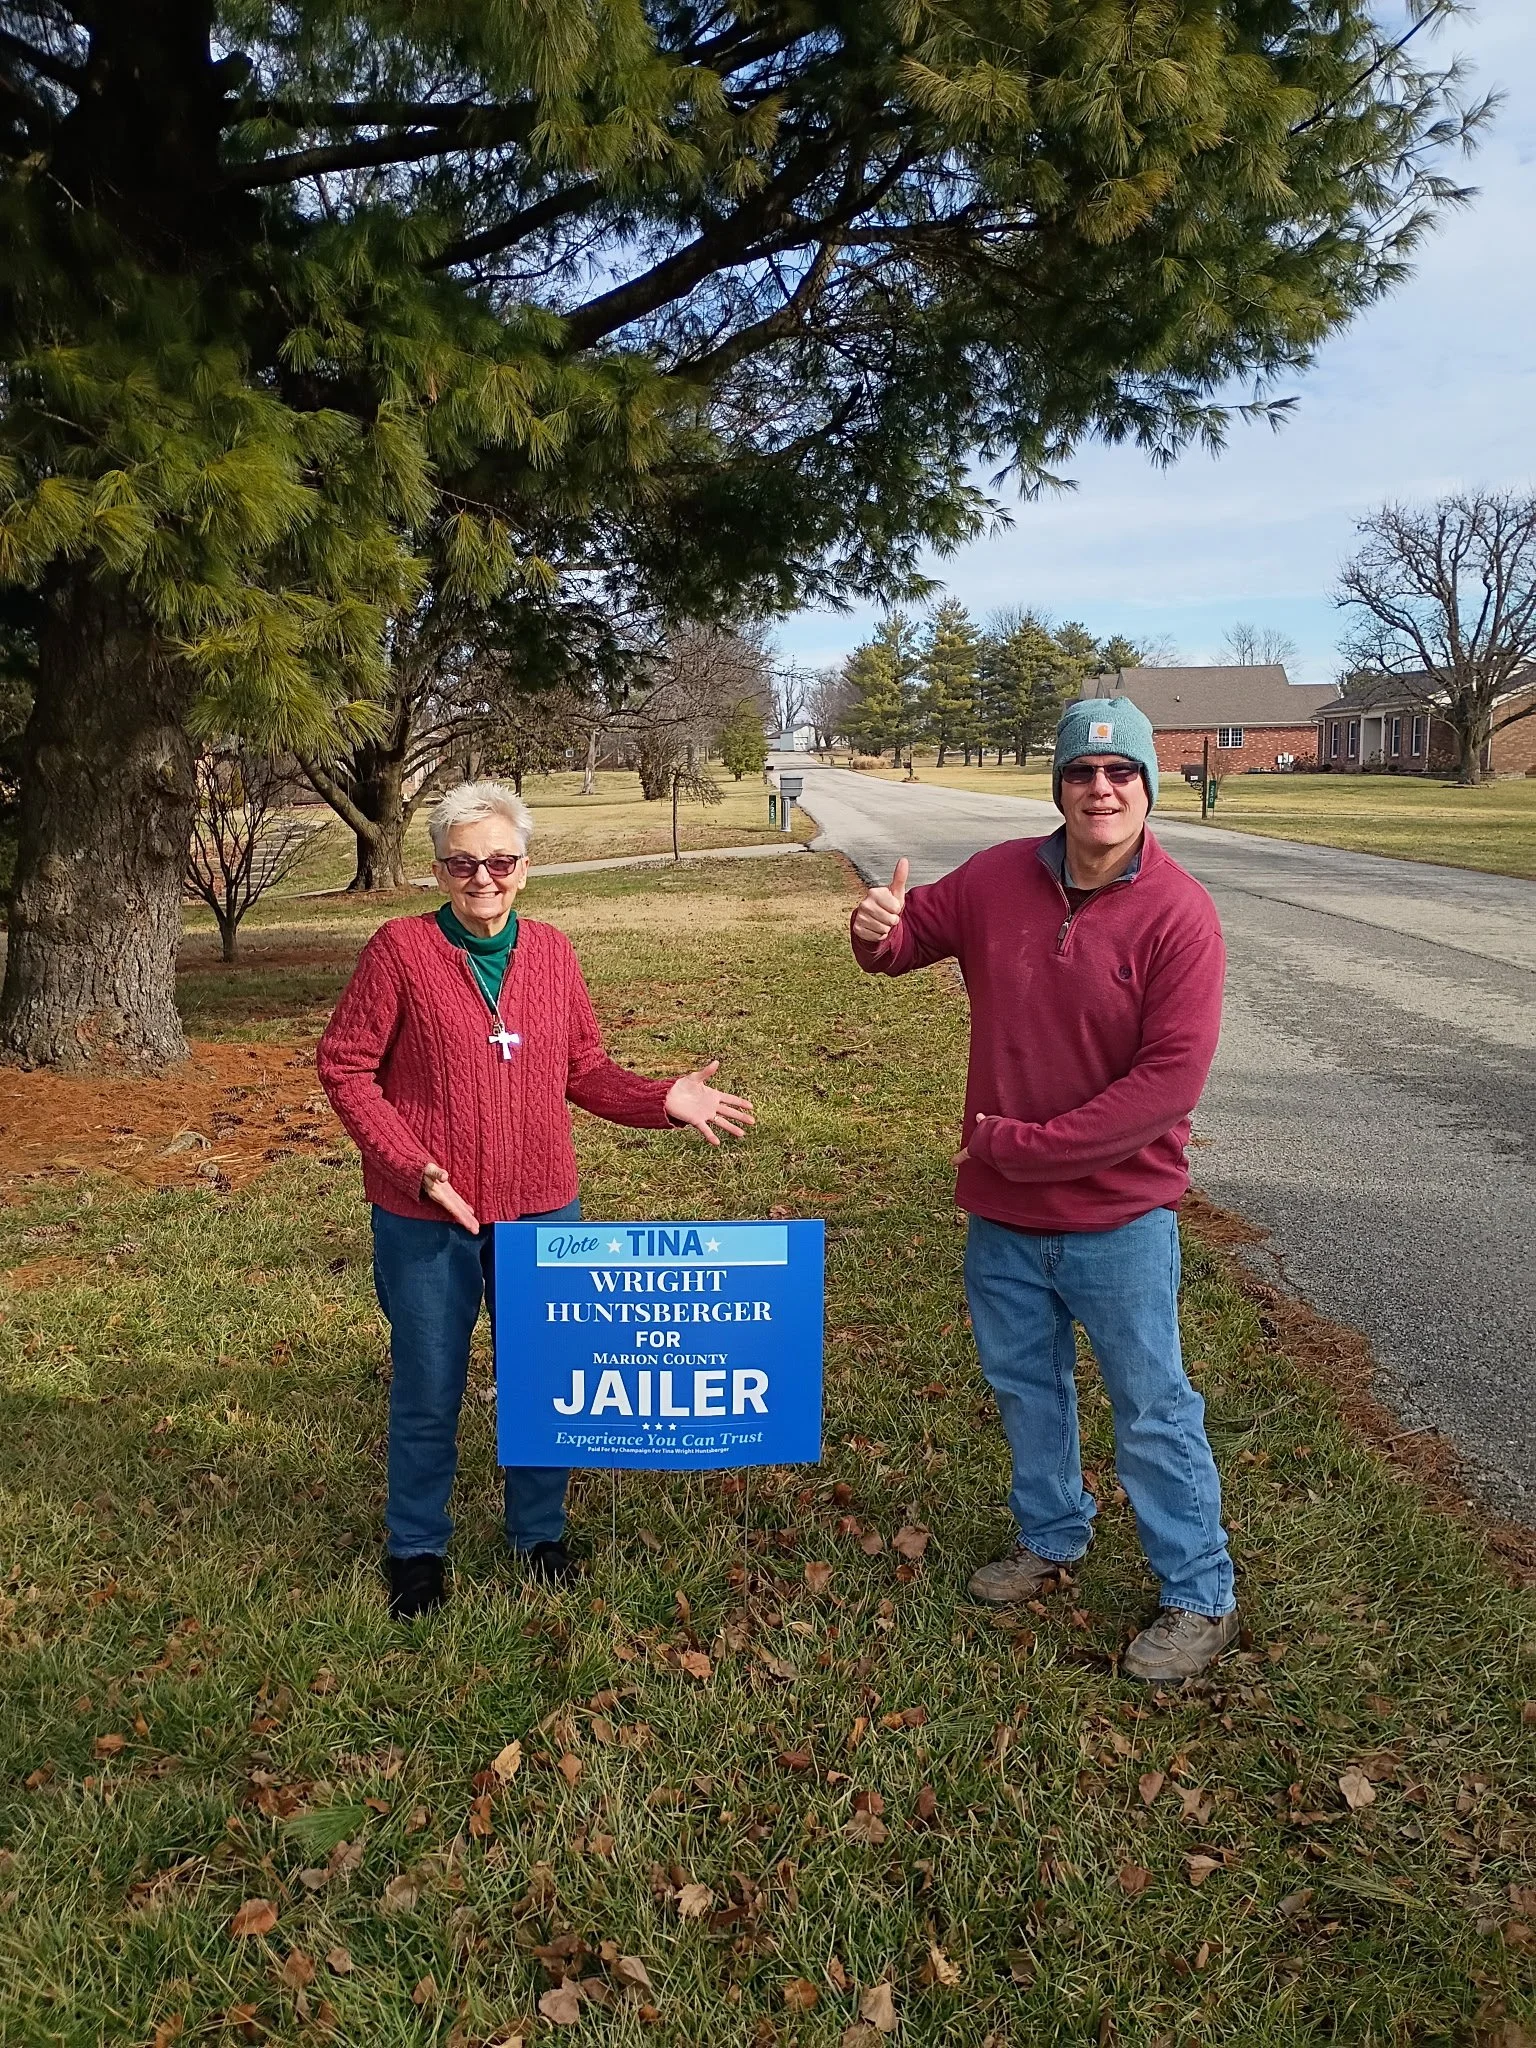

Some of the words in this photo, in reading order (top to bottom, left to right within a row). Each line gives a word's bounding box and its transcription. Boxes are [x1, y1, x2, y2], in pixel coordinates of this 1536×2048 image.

[547, 1234, 600, 1259] Vote
[627, 1230, 704, 1257] TINA
[589, 1270, 727, 1293] WRIGHT
[545, 1301, 772, 1323] HUNTSBERGER
[636, 1331, 681, 1348] FOR
[592, 1353, 658, 1365] MARION
[663, 1353, 728, 1365] COUNTY
[553, 1369, 769, 1417] JAILER
[556, 1432, 643, 1447] Experience
[648, 1434, 676, 1447] You
[682, 1435, 714, 1447] Can
[720, 1432, 763, 1444] Trust
